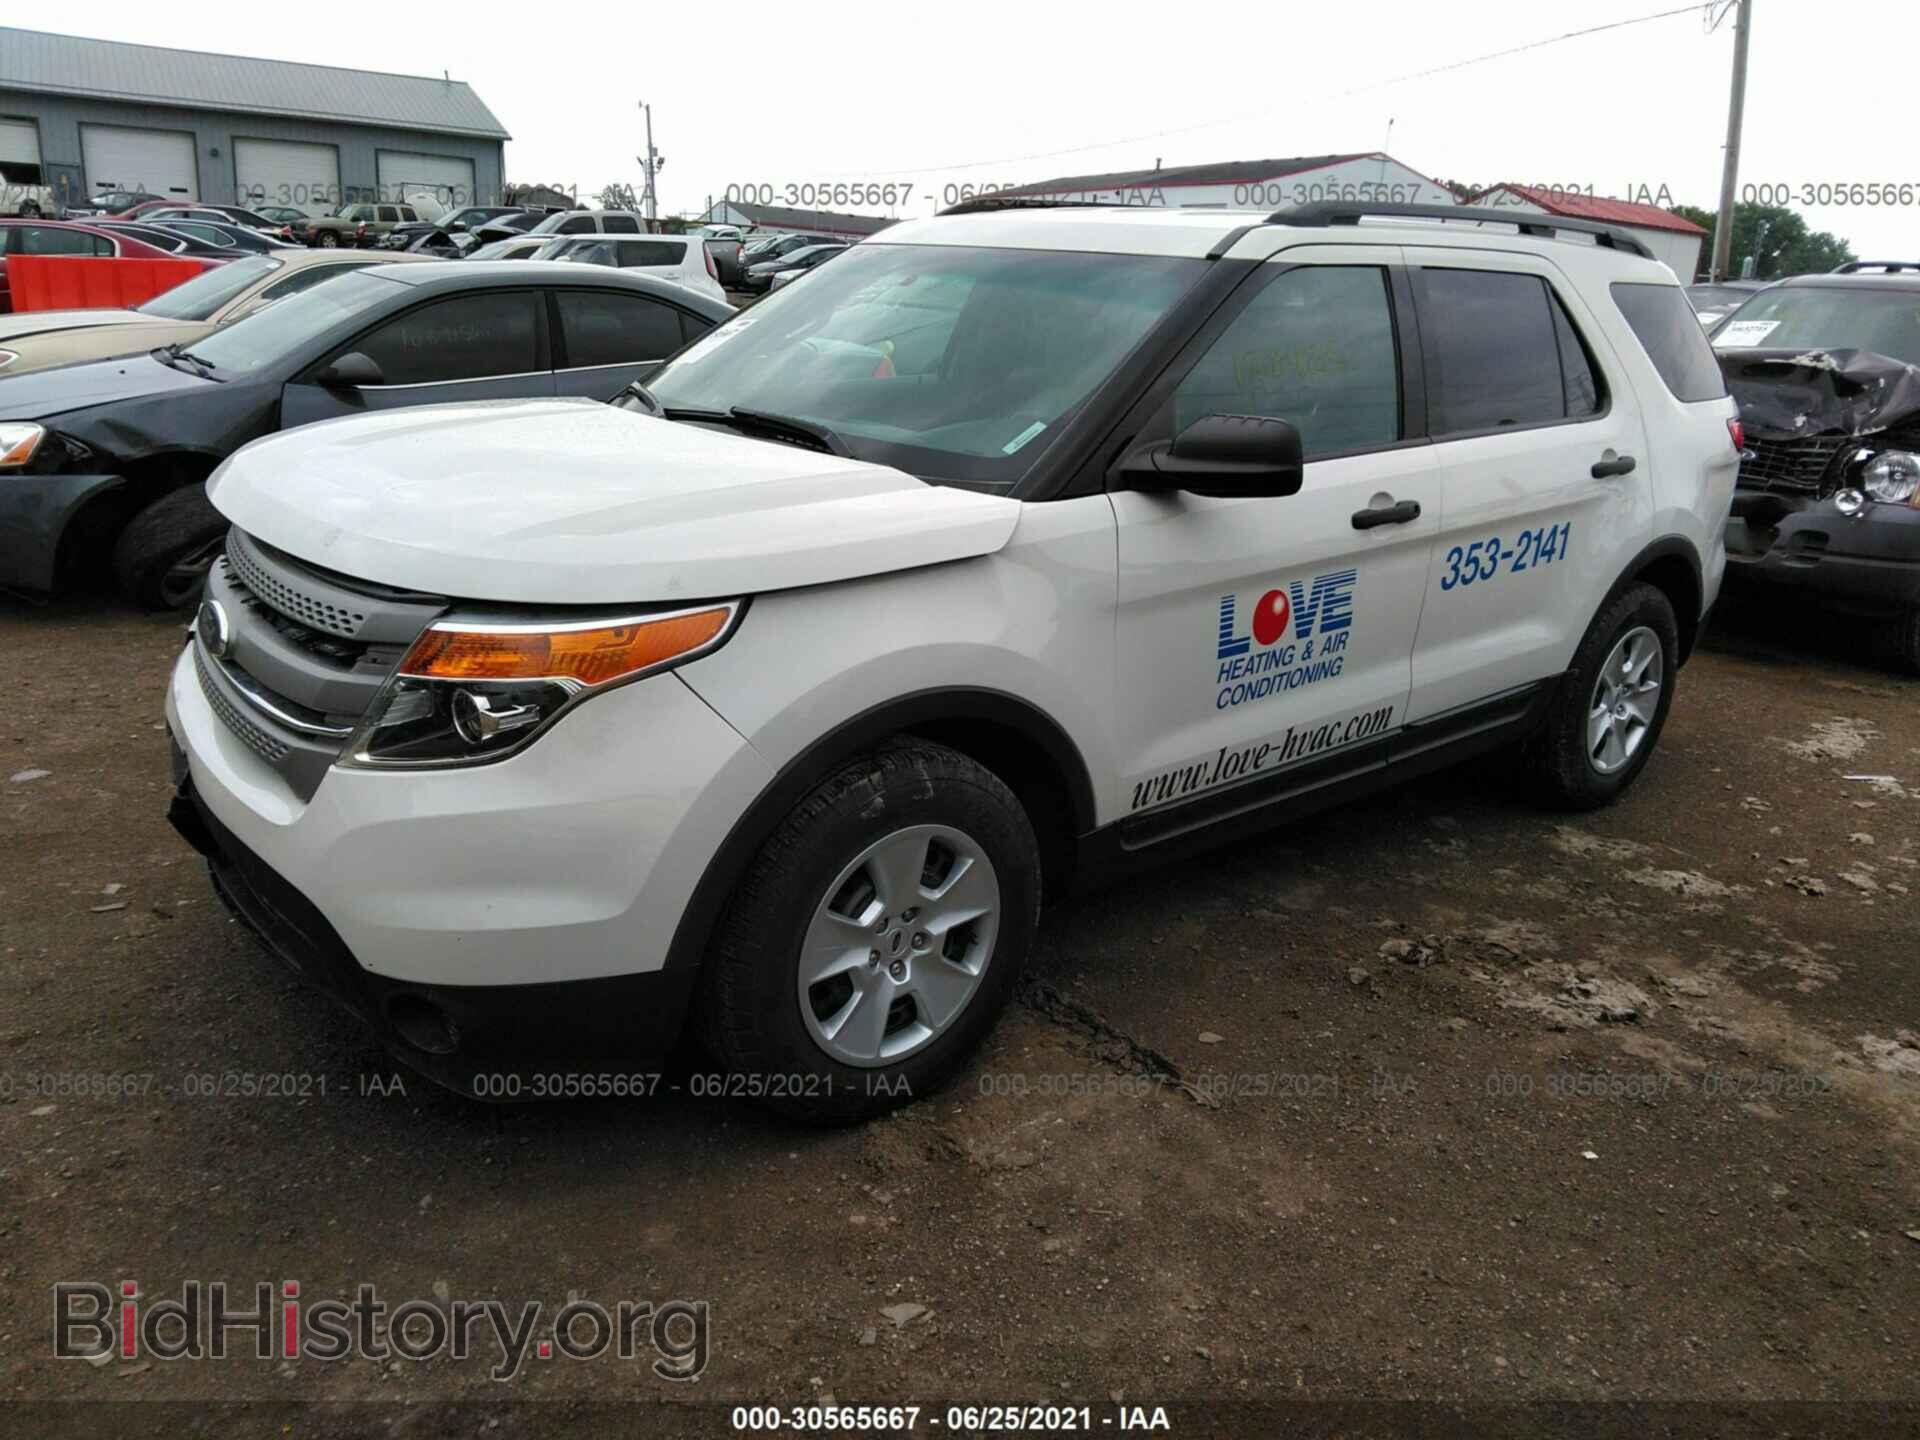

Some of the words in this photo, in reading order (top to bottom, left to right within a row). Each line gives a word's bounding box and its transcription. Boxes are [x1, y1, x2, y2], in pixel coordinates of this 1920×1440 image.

[1441, 521, 1571, 591] 353-2141
[1217, 568, 1357, 660] LOVE
[1216, 645, 1296, 684] HEATING
[1301, 640, 1314, 661] &
[1319, 631, 1350, 657] AIR
[1216, 656, 1344, 710] CONDITIONING
[1131, 705, 1394, 810] www.love-hvac.com
